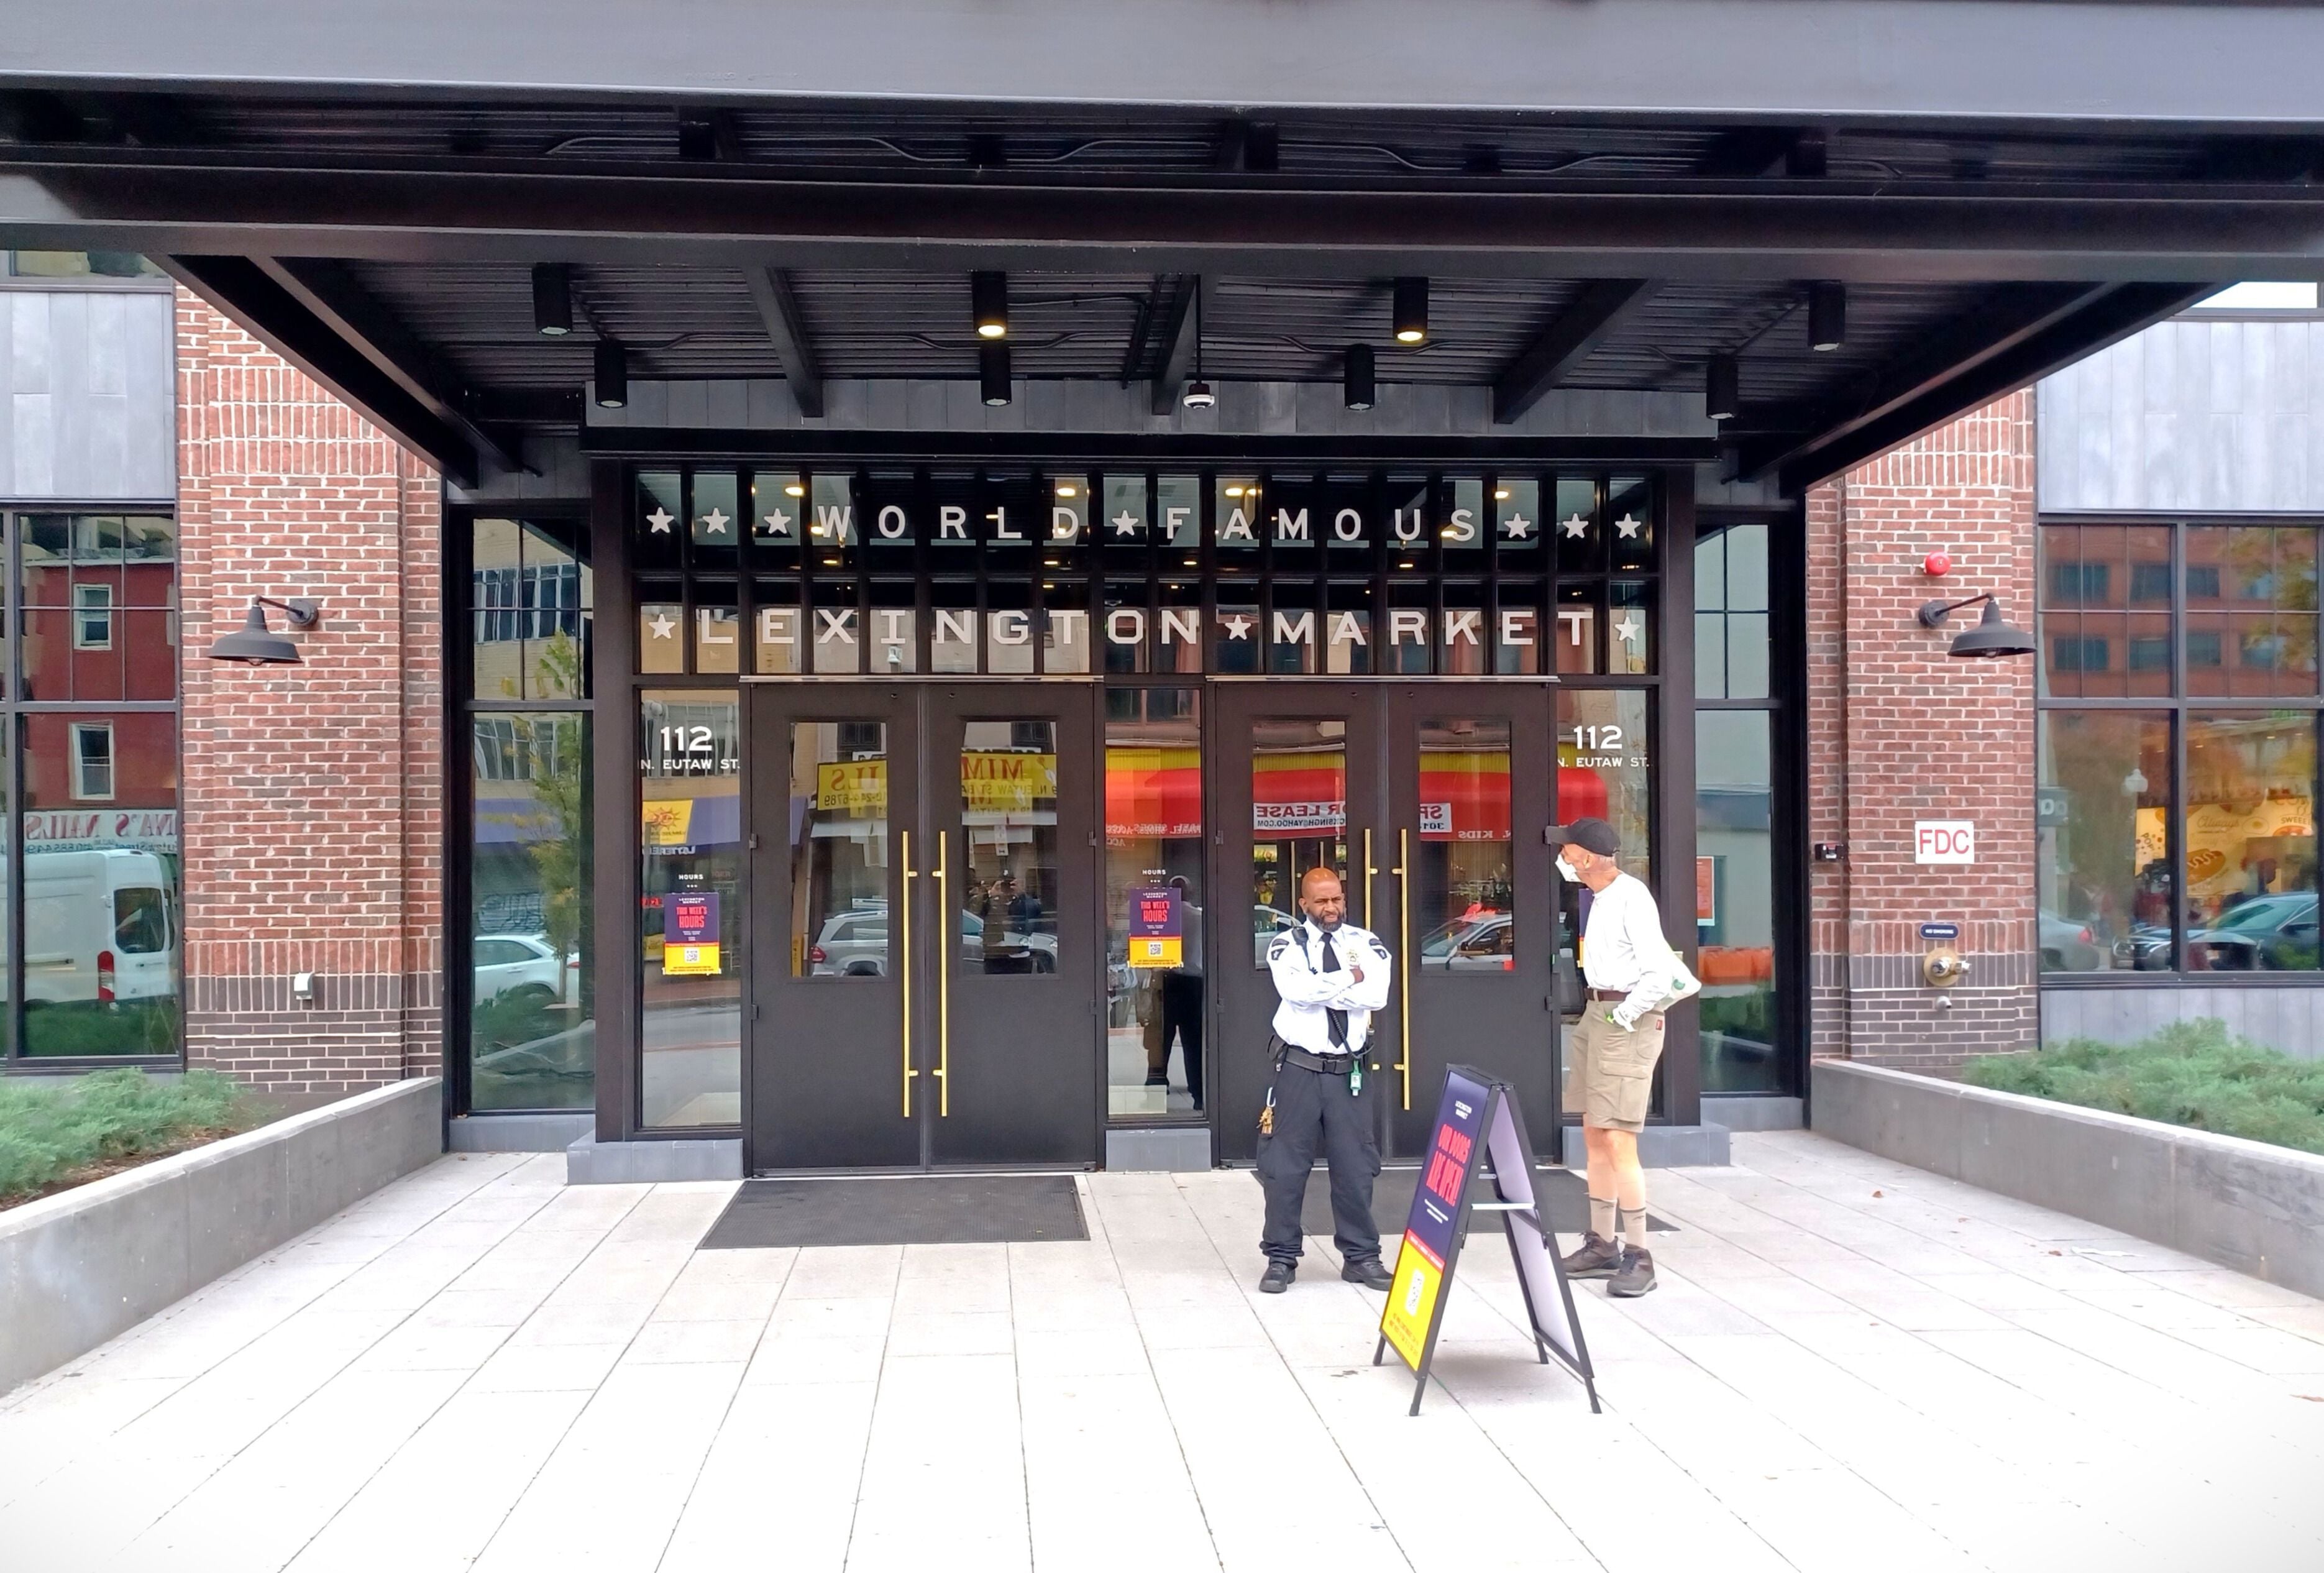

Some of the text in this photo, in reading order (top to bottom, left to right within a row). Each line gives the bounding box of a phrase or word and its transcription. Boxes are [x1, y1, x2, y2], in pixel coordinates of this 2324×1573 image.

[817, 505, 1476, 542] WORLD FAMOUS
[701, 608, 1594, 646] LEXINGTON MARKET
[661, 725, 713, 751] 112
[1573, 725, 1623, 750] 112
[641, 759, 741, 770] N. EUTAW ST.
[1576, 757, 1623, 768] EUTAW
[1630, 757, 1650, 768] ST.
[1919, 829, 1970, 855] FDC
[679, 915, 705, 929] HOURS
[1143, 909, 1168, 923] HOURS
